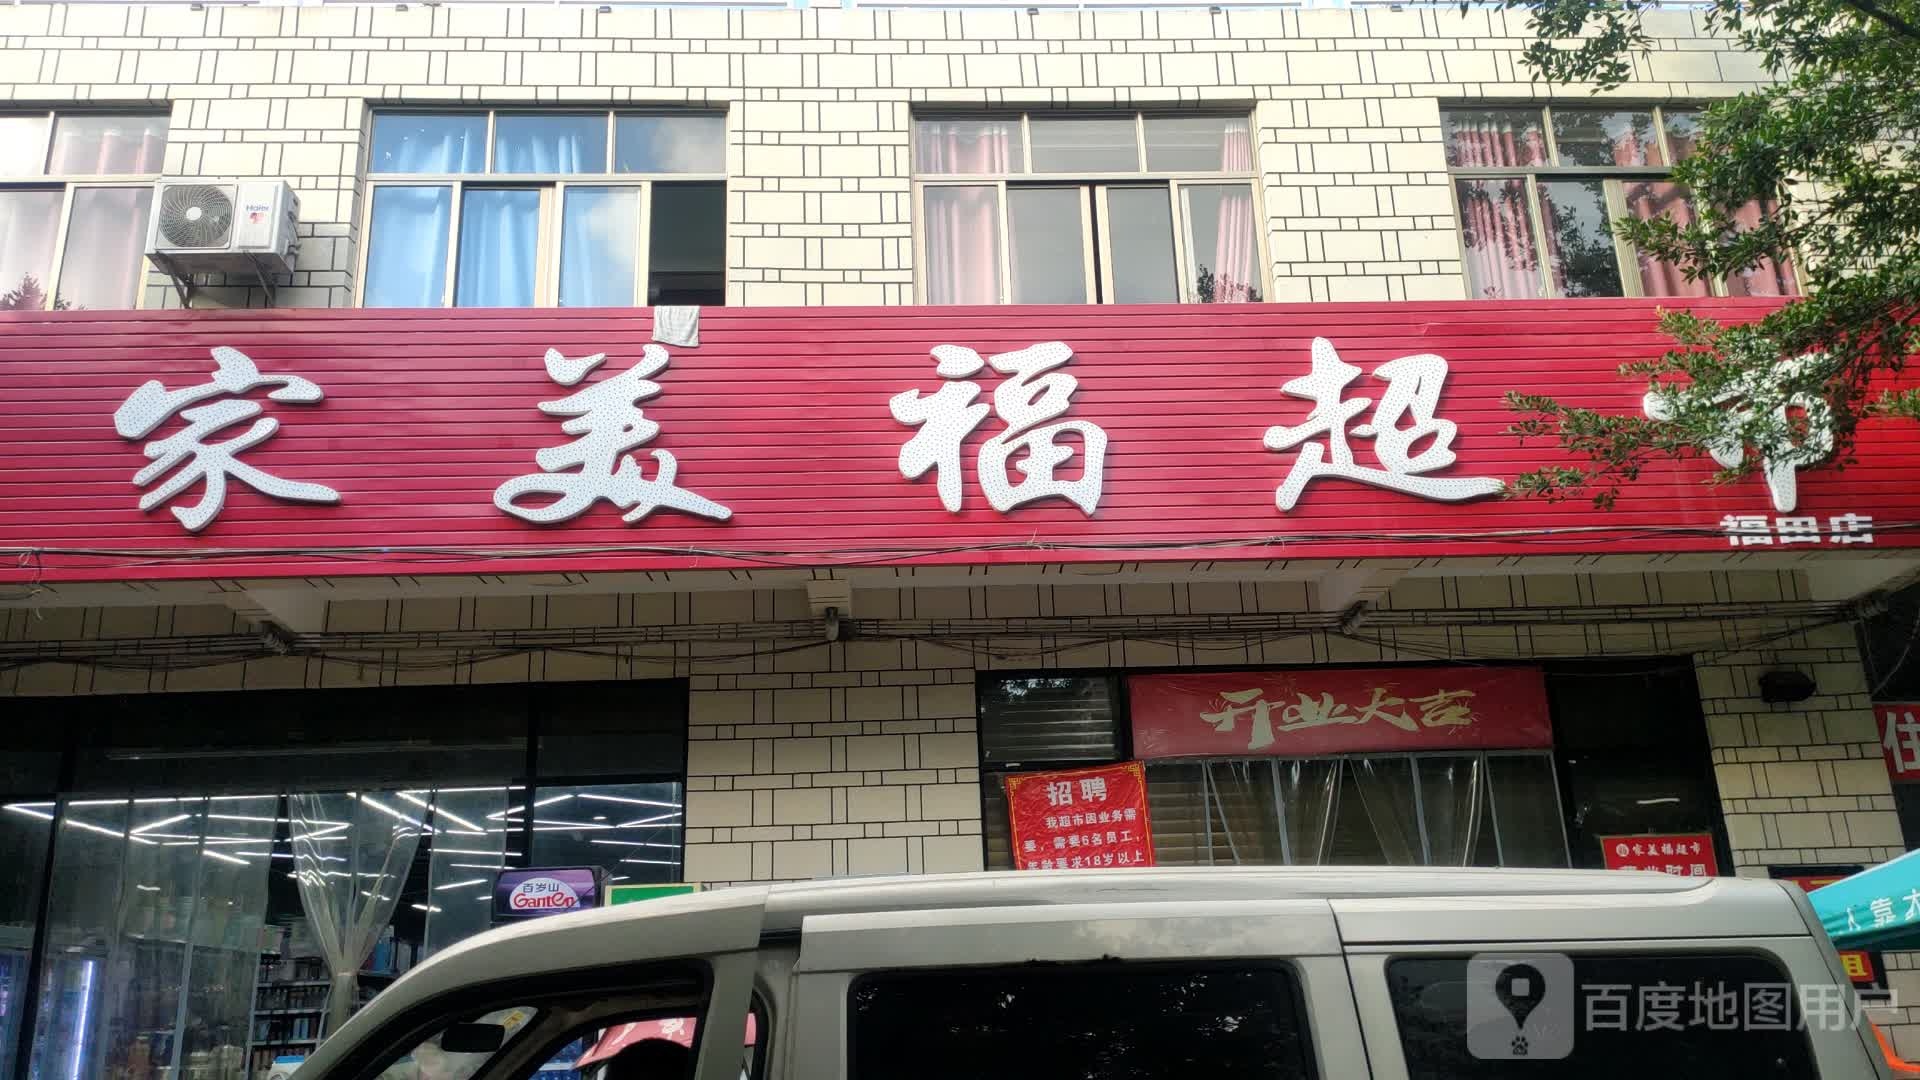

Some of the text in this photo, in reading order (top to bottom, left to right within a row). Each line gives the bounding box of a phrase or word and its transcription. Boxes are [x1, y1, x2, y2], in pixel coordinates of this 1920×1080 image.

[1720, 513, 1874, 546] 福田店
[1200, 687, 1476, 750] 开业大吉
[1047, 776, 1107, 806] 招聘
[1045, 807, 1137, 829] 我超市因业务需
[1632, 841, 1701, 856] 家美福超市
[522, 882, 560, 893] 百岁山
